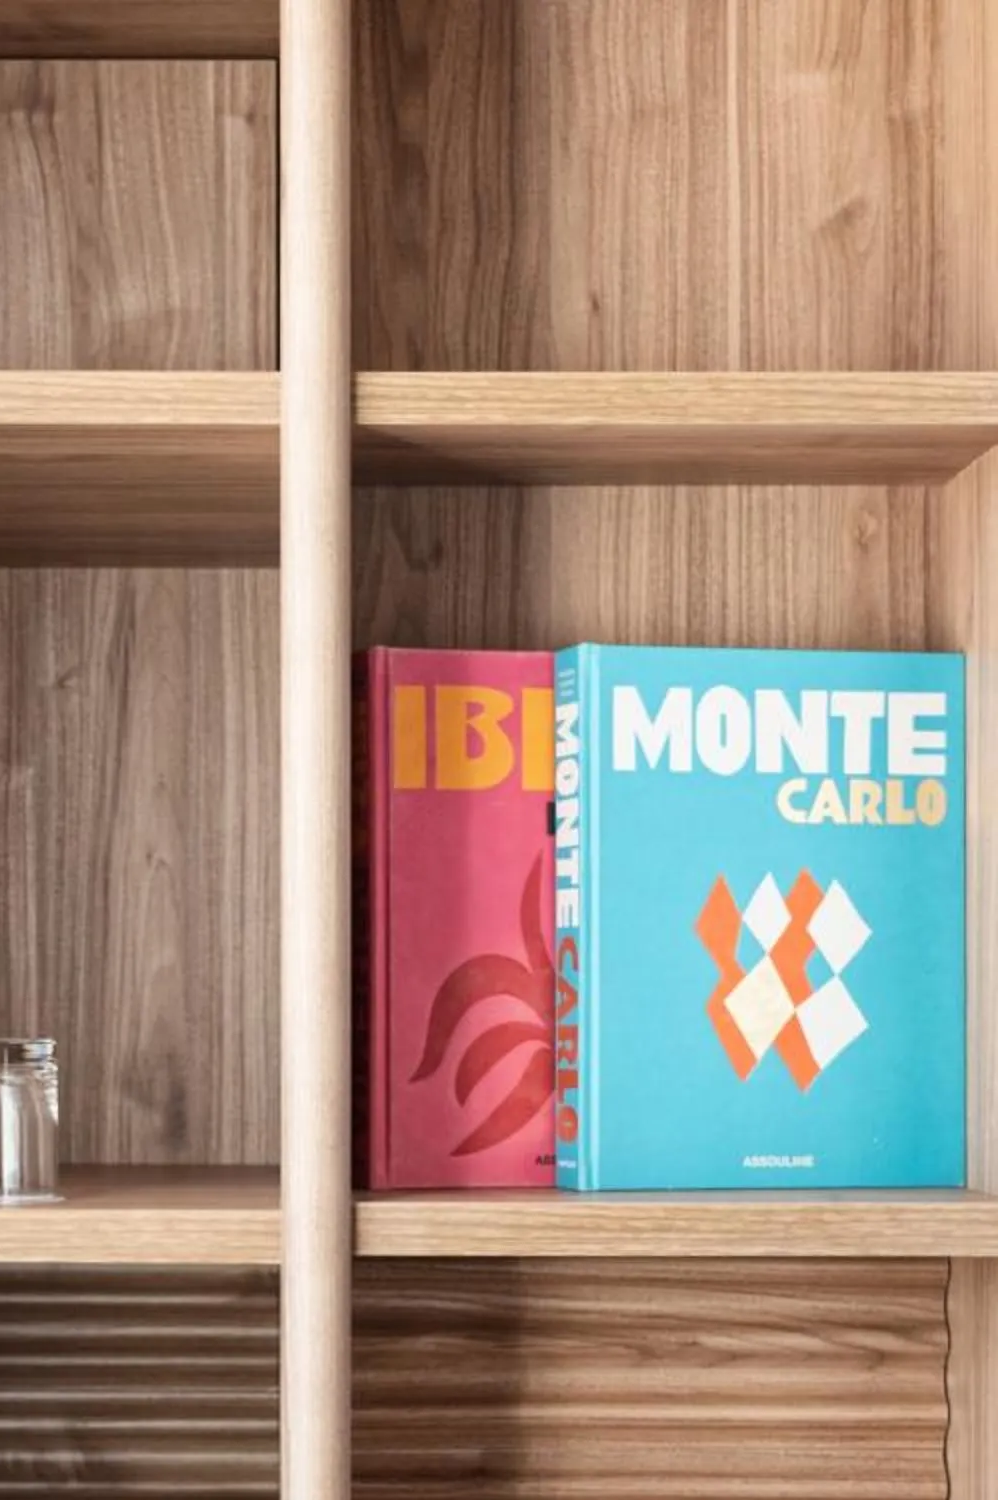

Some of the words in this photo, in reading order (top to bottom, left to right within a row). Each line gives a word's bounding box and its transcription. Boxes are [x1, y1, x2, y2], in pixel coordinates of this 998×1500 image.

[612, 684, 948, 777] MONTE
[555, 703, 579, 929] MONTE
[775, 778, 948, 826] CARLO
[556, 936, 579, 1144] CARLO
[743, 1155, 815, 1168] ASSOULINE
